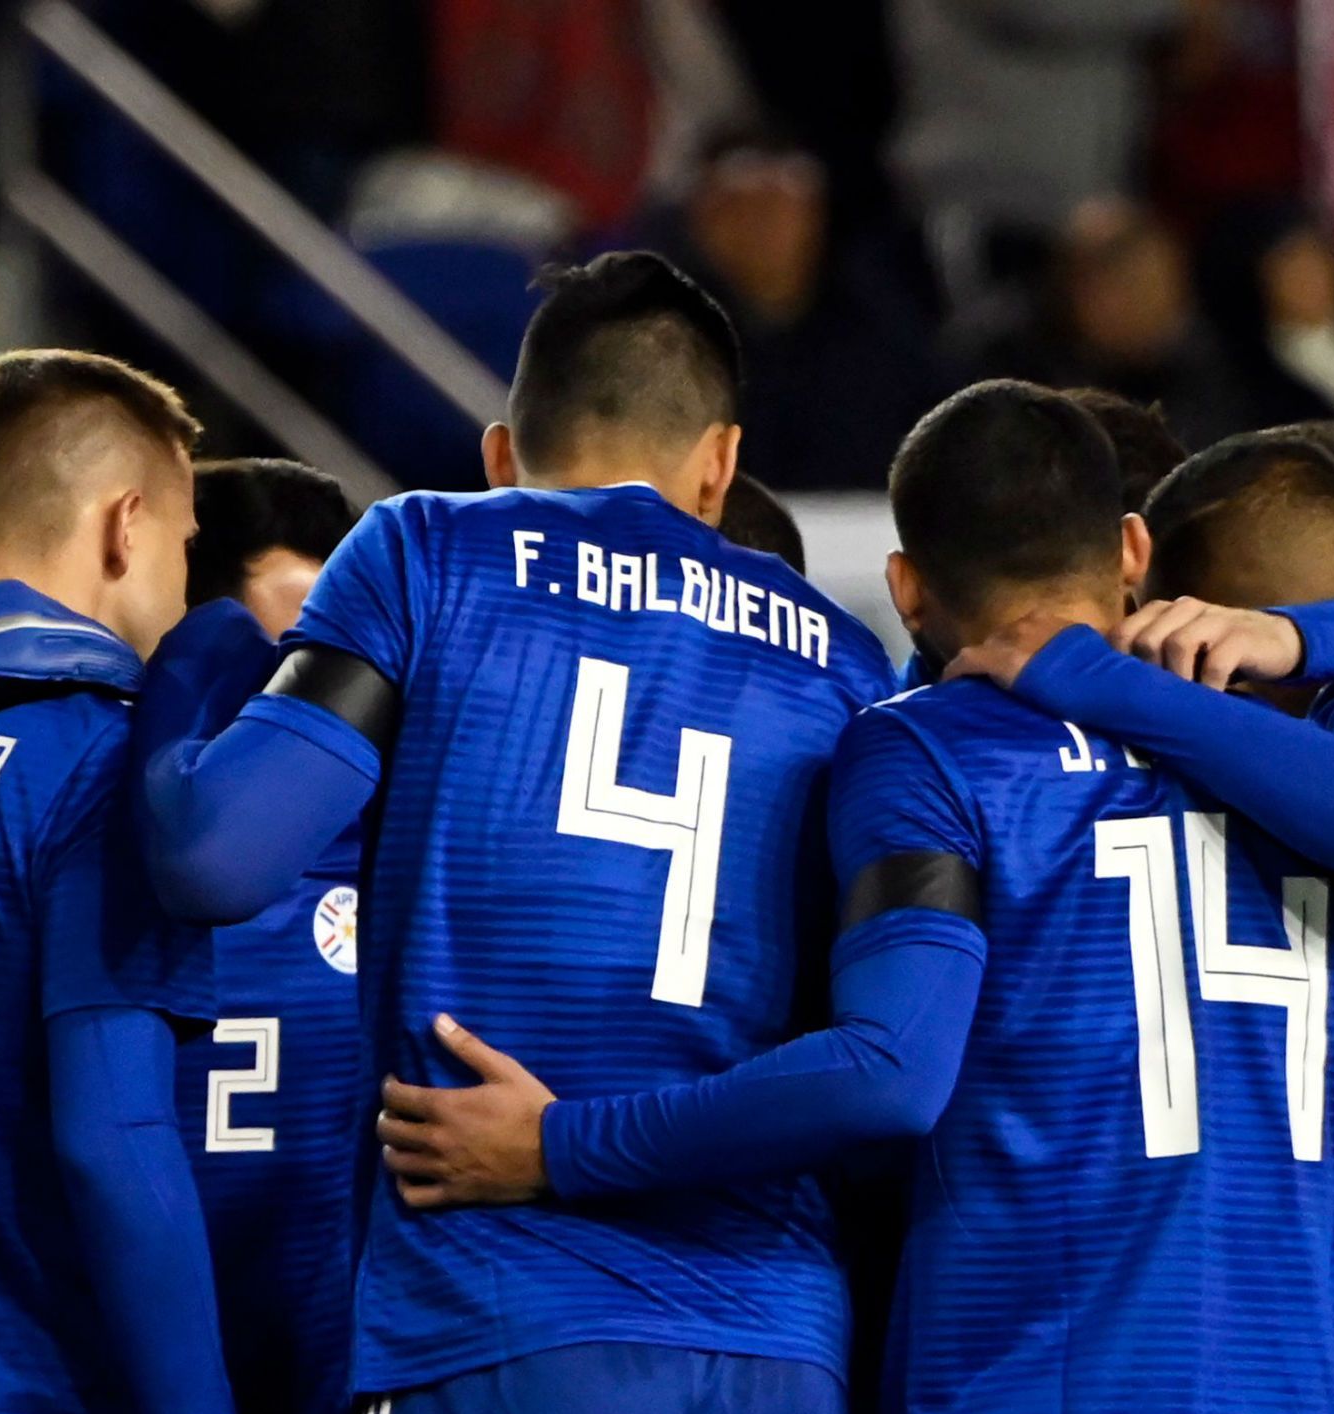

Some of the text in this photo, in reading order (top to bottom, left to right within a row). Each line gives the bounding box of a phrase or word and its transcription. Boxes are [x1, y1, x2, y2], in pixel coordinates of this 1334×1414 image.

[512, 530, 830, 668] F. BALBUENA
[556, 656, 732, 1008] 4
[205, 1017, 280, 1153] 2
[1095, 811, 1330, 1163] 14
